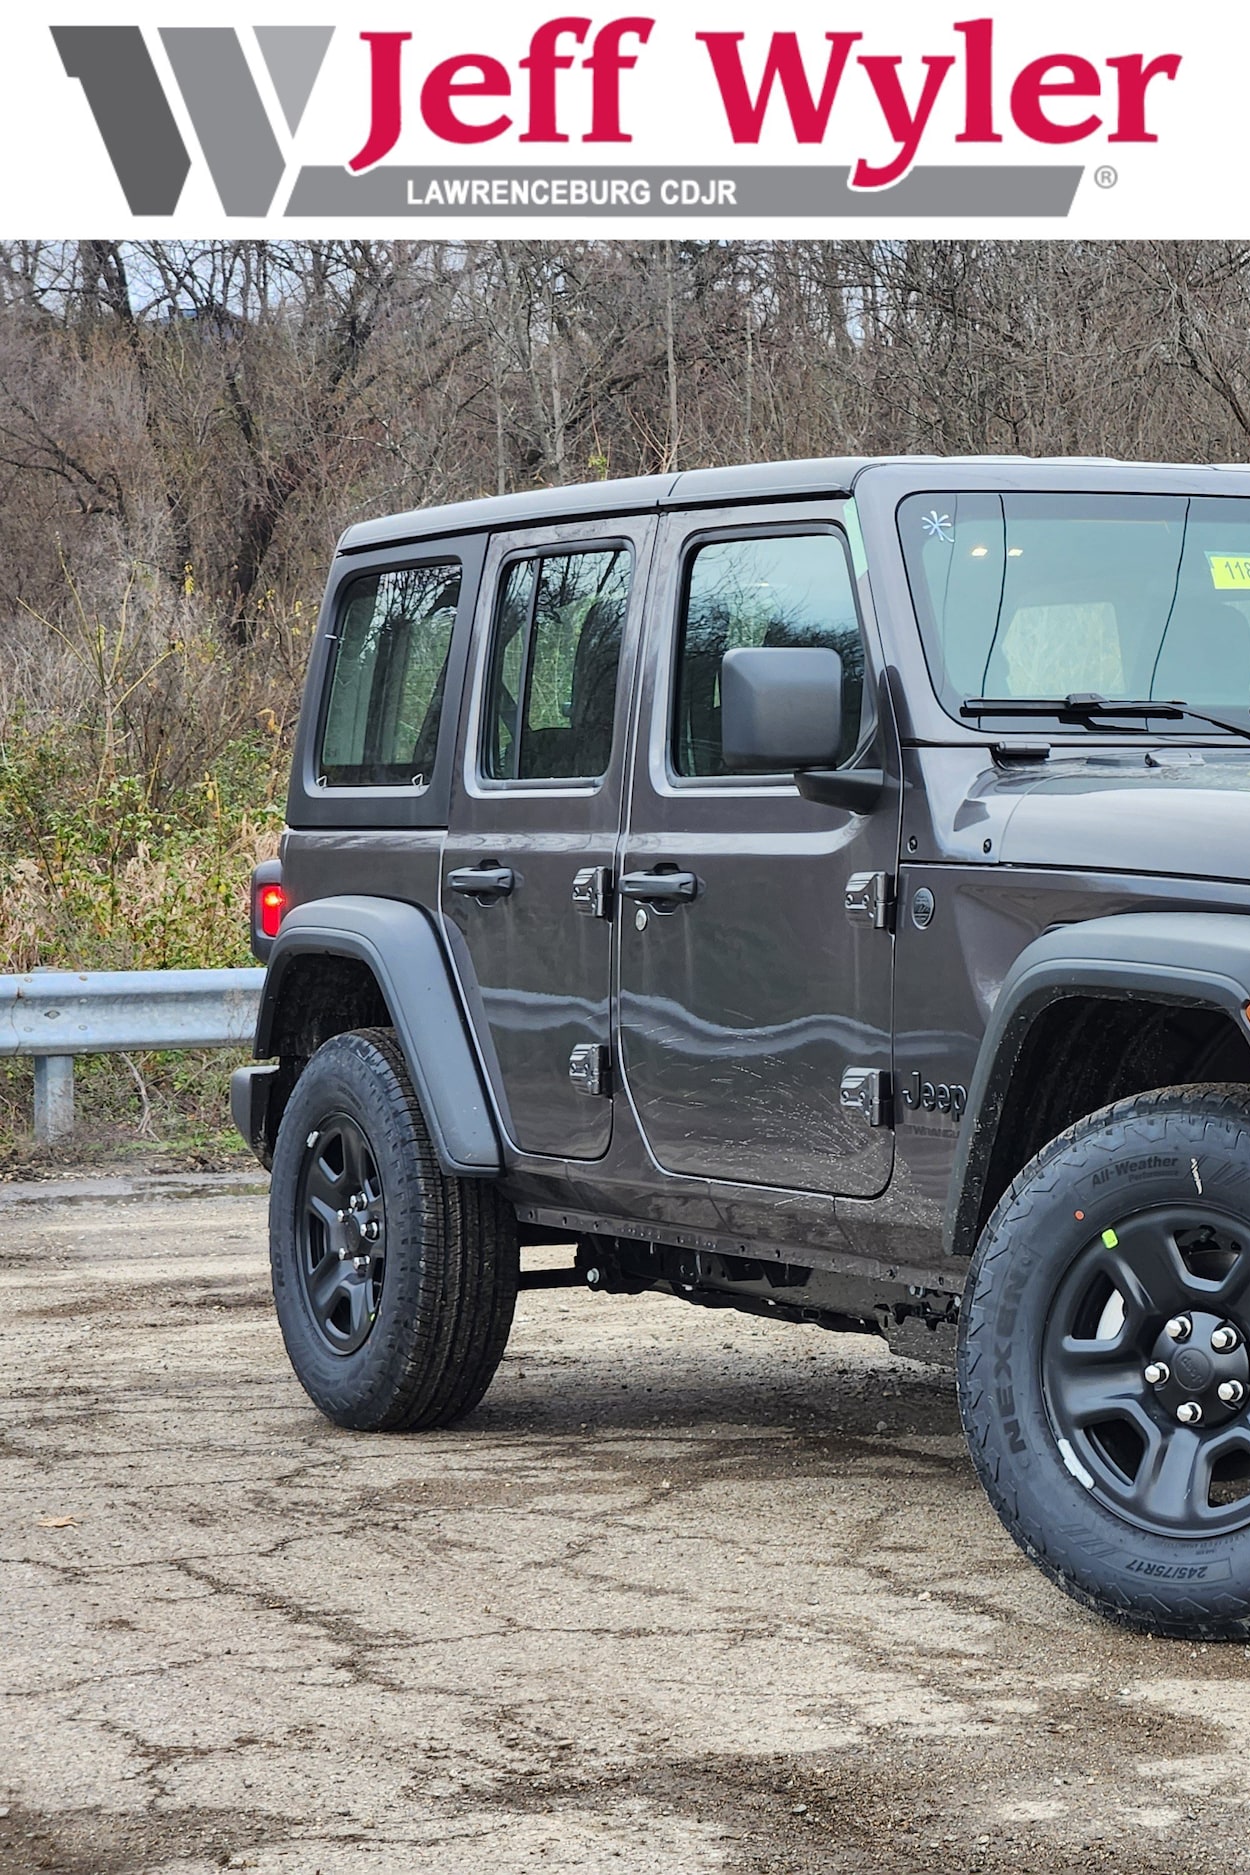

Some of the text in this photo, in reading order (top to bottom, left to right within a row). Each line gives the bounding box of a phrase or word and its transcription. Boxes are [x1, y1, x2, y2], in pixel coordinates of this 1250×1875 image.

[901, 1070, 968, 1123] Jeep
[1091, 1155, 1180, 1188] All-Weather
[994, 1268, 1031, 1454] NEXEN
[1125, 1559, 1209, 1580] 245/75R17
